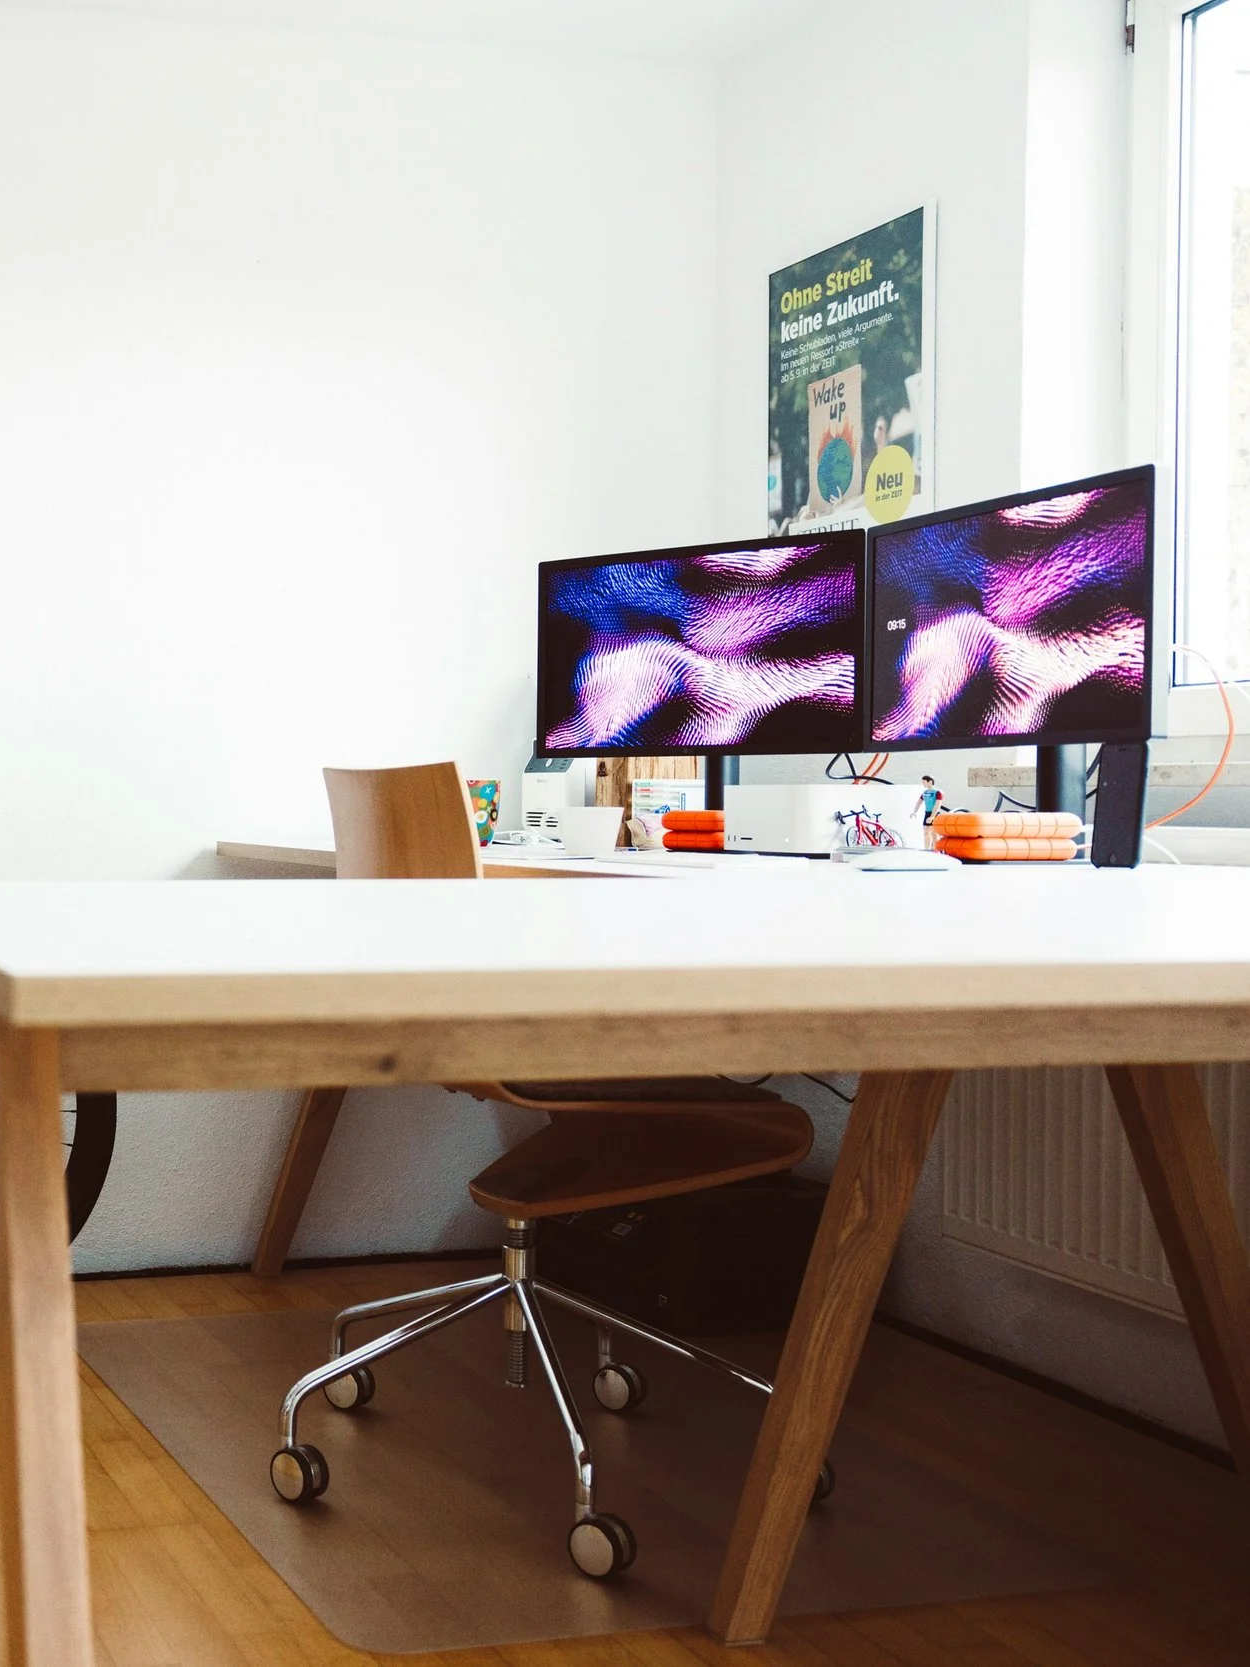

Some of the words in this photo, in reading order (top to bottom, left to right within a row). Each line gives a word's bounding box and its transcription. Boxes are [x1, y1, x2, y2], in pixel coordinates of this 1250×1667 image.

[781, 283, 822, 314] Ohne
[826, 258, 873, 296] Streit
[781, 312, 823, 344] keine
[827, 280, 899, 326] Zukunft.
[781, 348, 798, 360] Keine
[837, 326, 853, 339] viele
[854, 312, 894, 334] Argumente.
[780, 362, 789, 372] Im
[790, 355, 809, 368] neuen
[810, 345, 834, 361] Ressort
[780, 374, 789, 384] ab
[803, 366, 809, 375] in
[810, 362, 821, 373] der
[822, 355, 836, 370] ZEIT
[812, 378, 845, 407] Wake
[829, 401, 846, 423] up
[876, 472, 903, 492] Neu
[881, 493, 890, 501] der
[891, 489, 903, 499] ZEIT
